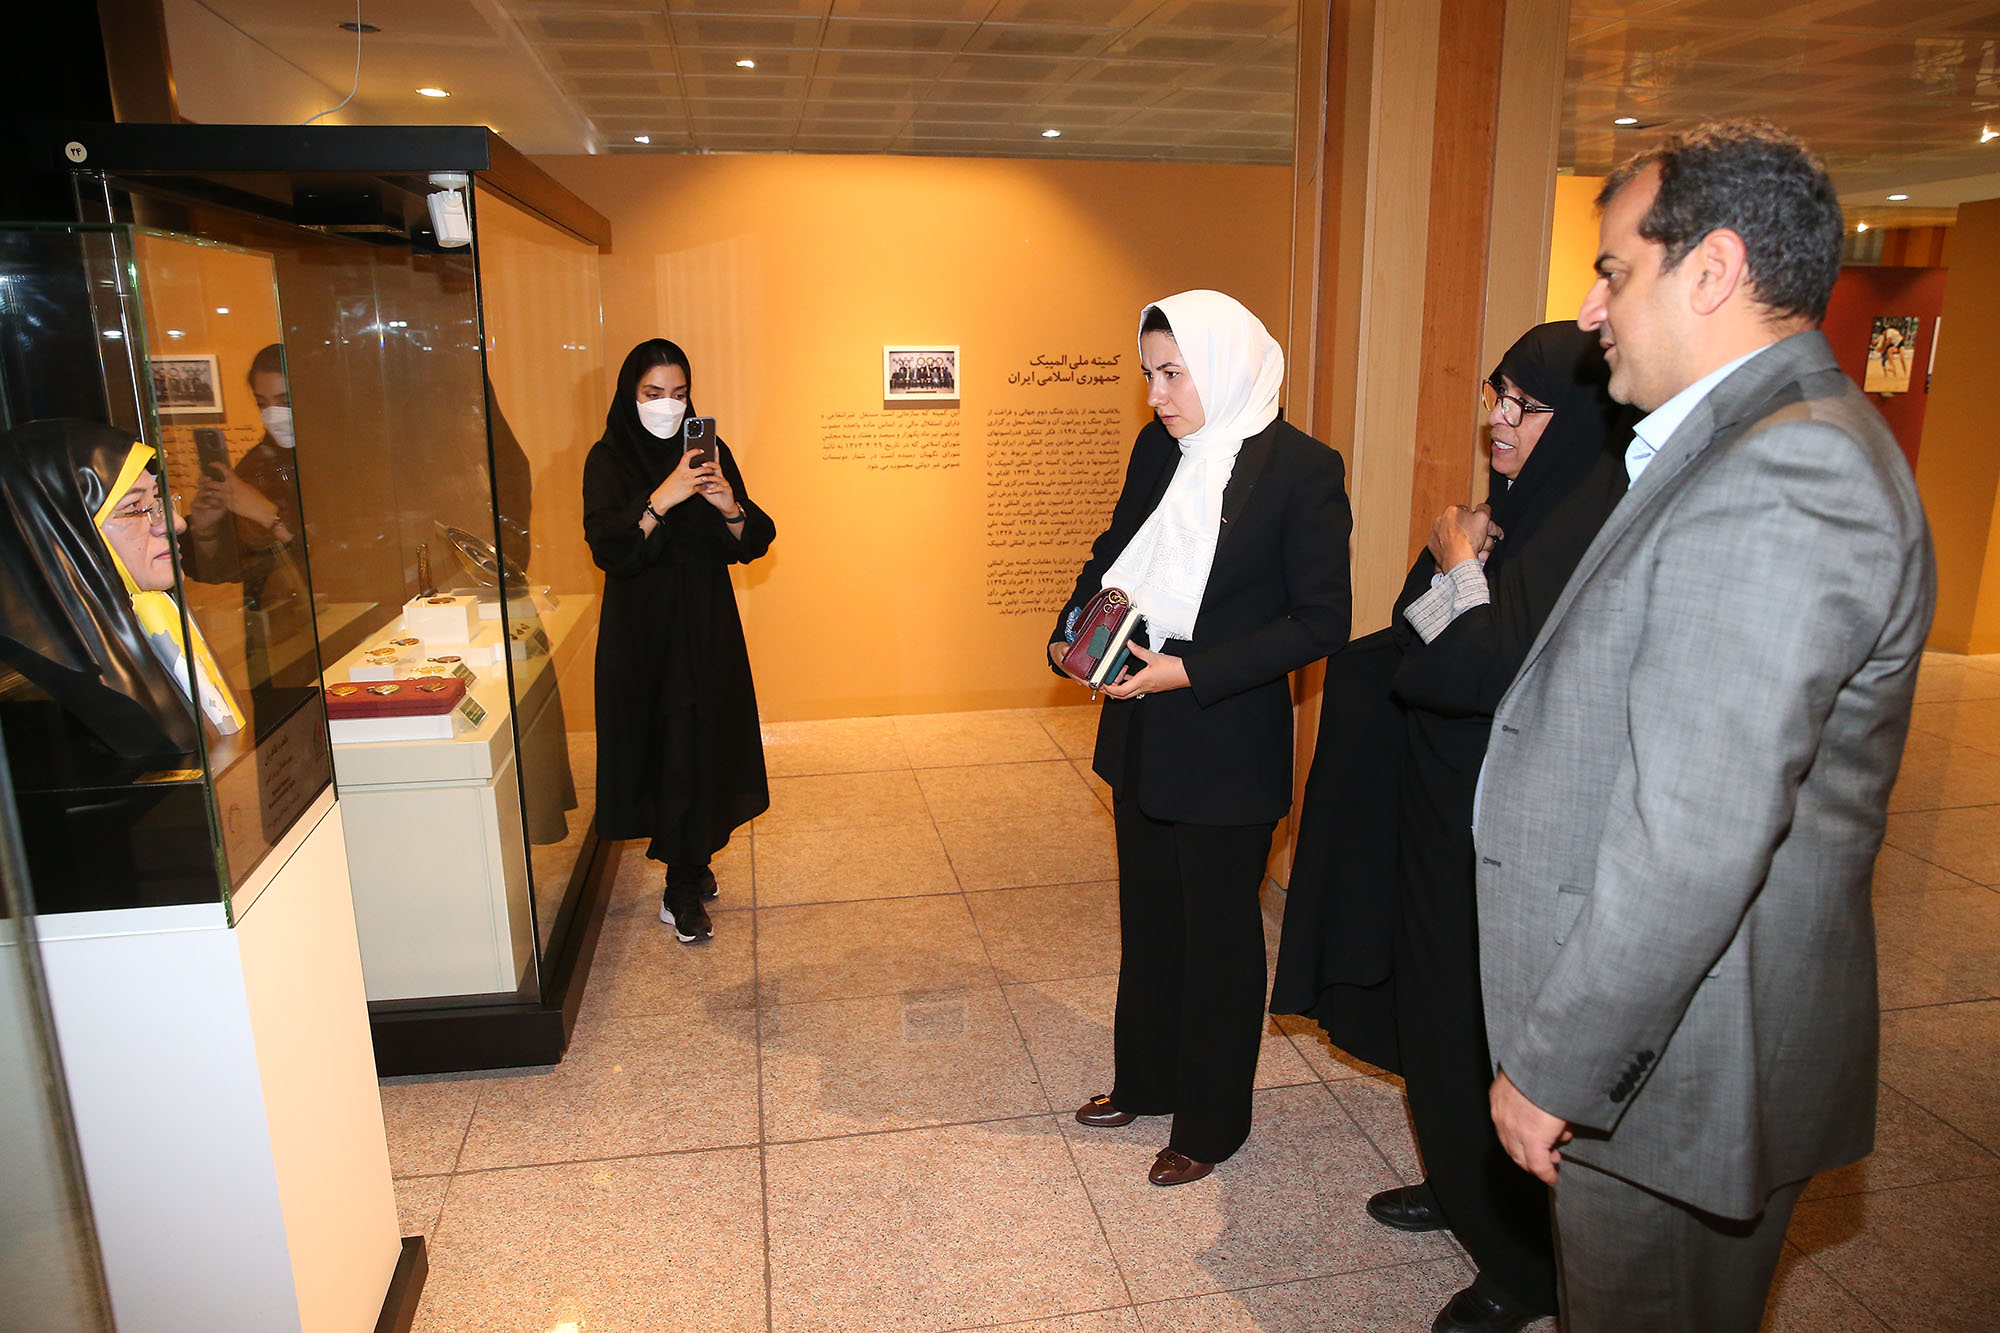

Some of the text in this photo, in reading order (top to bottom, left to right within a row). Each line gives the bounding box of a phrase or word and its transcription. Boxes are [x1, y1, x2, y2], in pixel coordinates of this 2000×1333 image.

[1029, 354, 1121, 370] کمیته ملی المپیک
[1007, 370, 1121, 386] جمهوری اسلامی ایران
